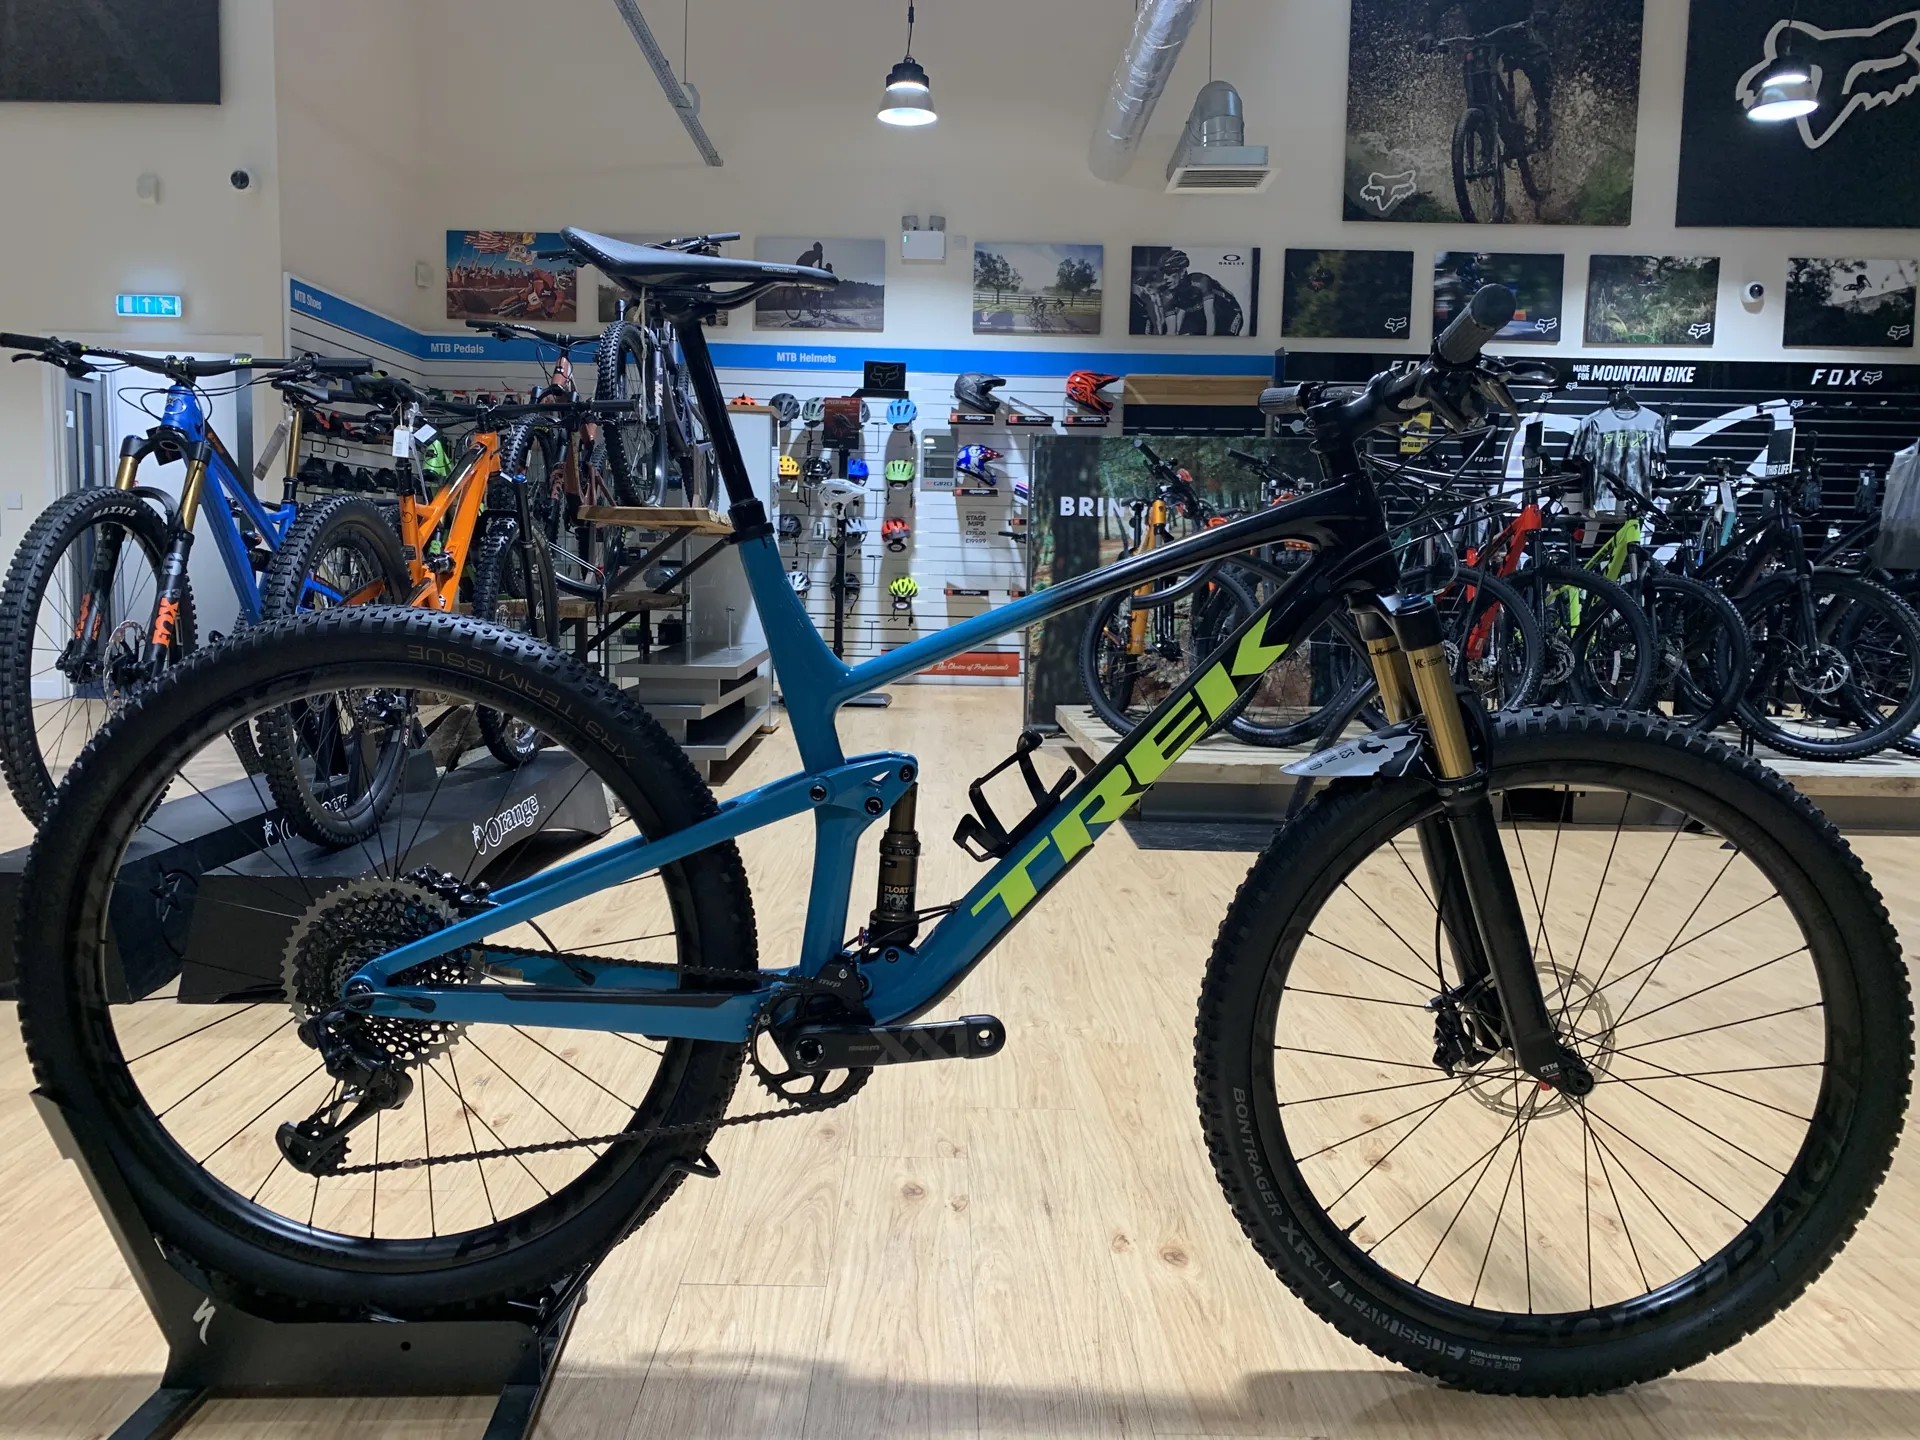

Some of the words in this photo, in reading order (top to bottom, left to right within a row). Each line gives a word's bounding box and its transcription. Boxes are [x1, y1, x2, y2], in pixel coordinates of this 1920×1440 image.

[294, 288, 306, 303] MTB
[306, 295, 322, 310] Shoes
[430, 342, 451, 353] MTB
[453, 343, 484, 354] Pedals
[777, 352, 797, 362] MTB
[800, 353, 837, 364] Helmets
[1572, 364, 1590, 373] MADE
[1577, 372, 1590, 381] FOR
[1591, 364, 1662, 382] MOUNTAIN
[1663, 366, 1696, 383] BIKE
[1810, 369, 1861, 386] FOX
[1603, 431, 1647, 450] FOX
[1778, 463, 1790, 475] LIFE
[93, 504, 138, 520] MAXXIS
[406, 644, 492, 676] ISSUE
[936, 661, 947, 671] The
[947, 662, 966, 671] Choice
[966, 663, 973, 671] of
[973, 662, 1010, 671] Professionals
[498, 668, 574, 720] TEAM
[970, 608, 1289, 919] TREK
[484, 793, 540, 848] Orange
[884, 885, 909, 895] FLOAT
[883, 893, 909, 911] FOX
[818, 977, 842, 989] mrp
[869, 1021, 969, 1066] XX1
[1539, 1062, 1560, 1073] FIT4
[1233, 1087, 1283, 1217] BONTRAGER
[1279, 1218, 1331, 1282] XR4
